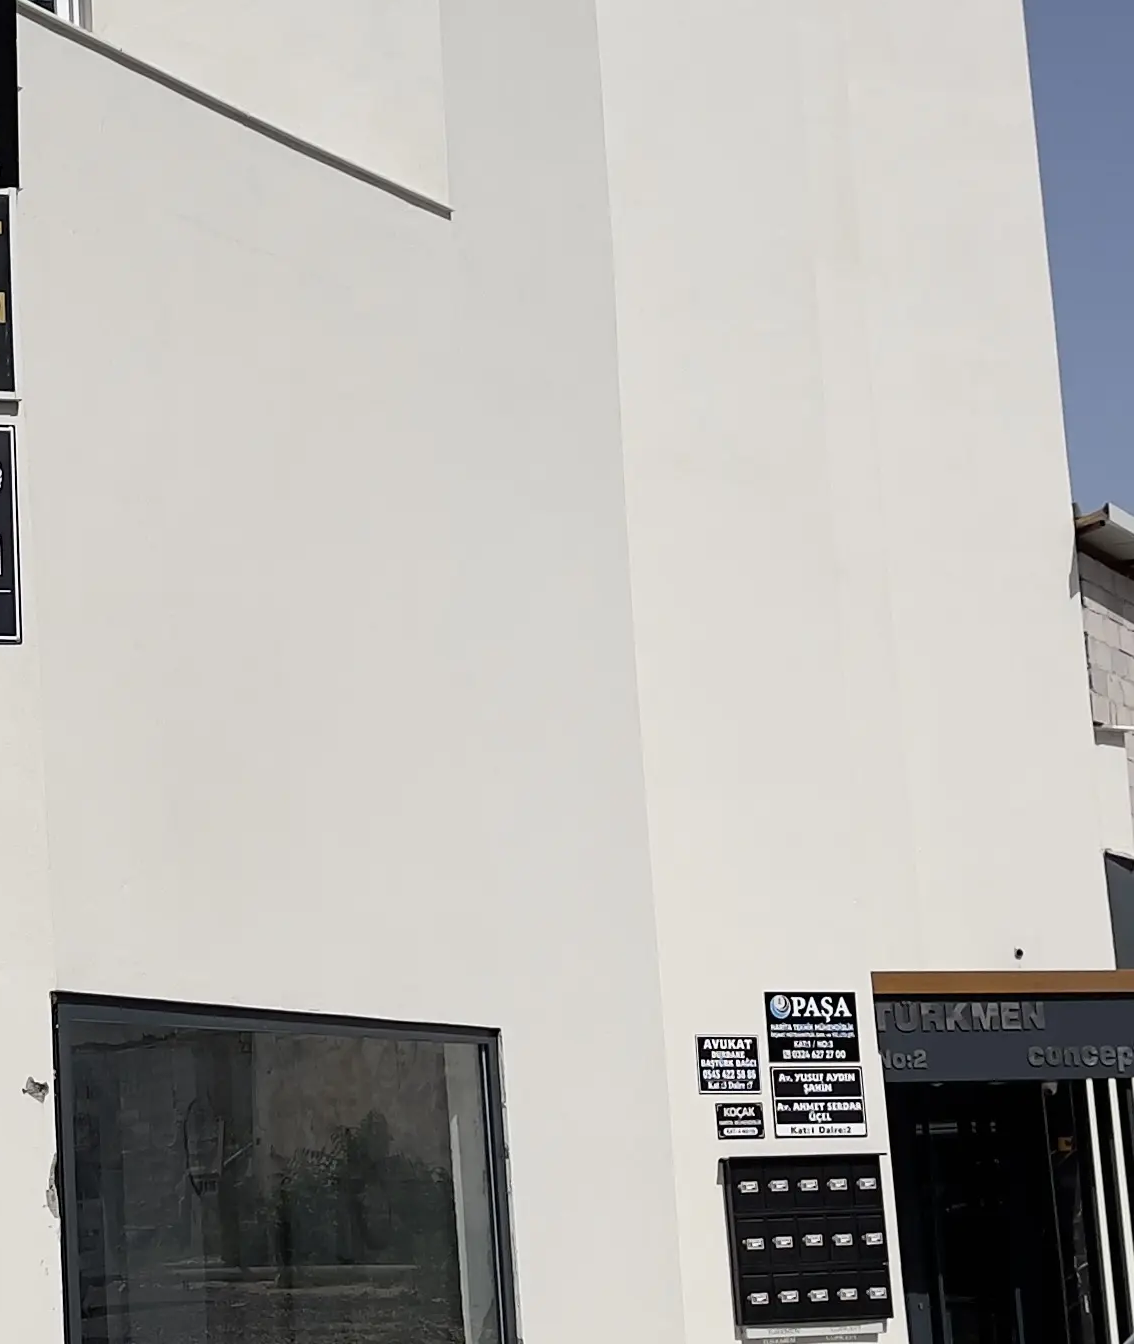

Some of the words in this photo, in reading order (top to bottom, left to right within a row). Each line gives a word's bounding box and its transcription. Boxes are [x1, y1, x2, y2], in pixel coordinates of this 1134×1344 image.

[790, 996, 852, 1023] PAŞA
[874, 1001, 1045, 1032] TÜRKMEN
[703, 1039, 752, 1050] AVUKAT
[1027, 1045, 1134, 1073] concep
